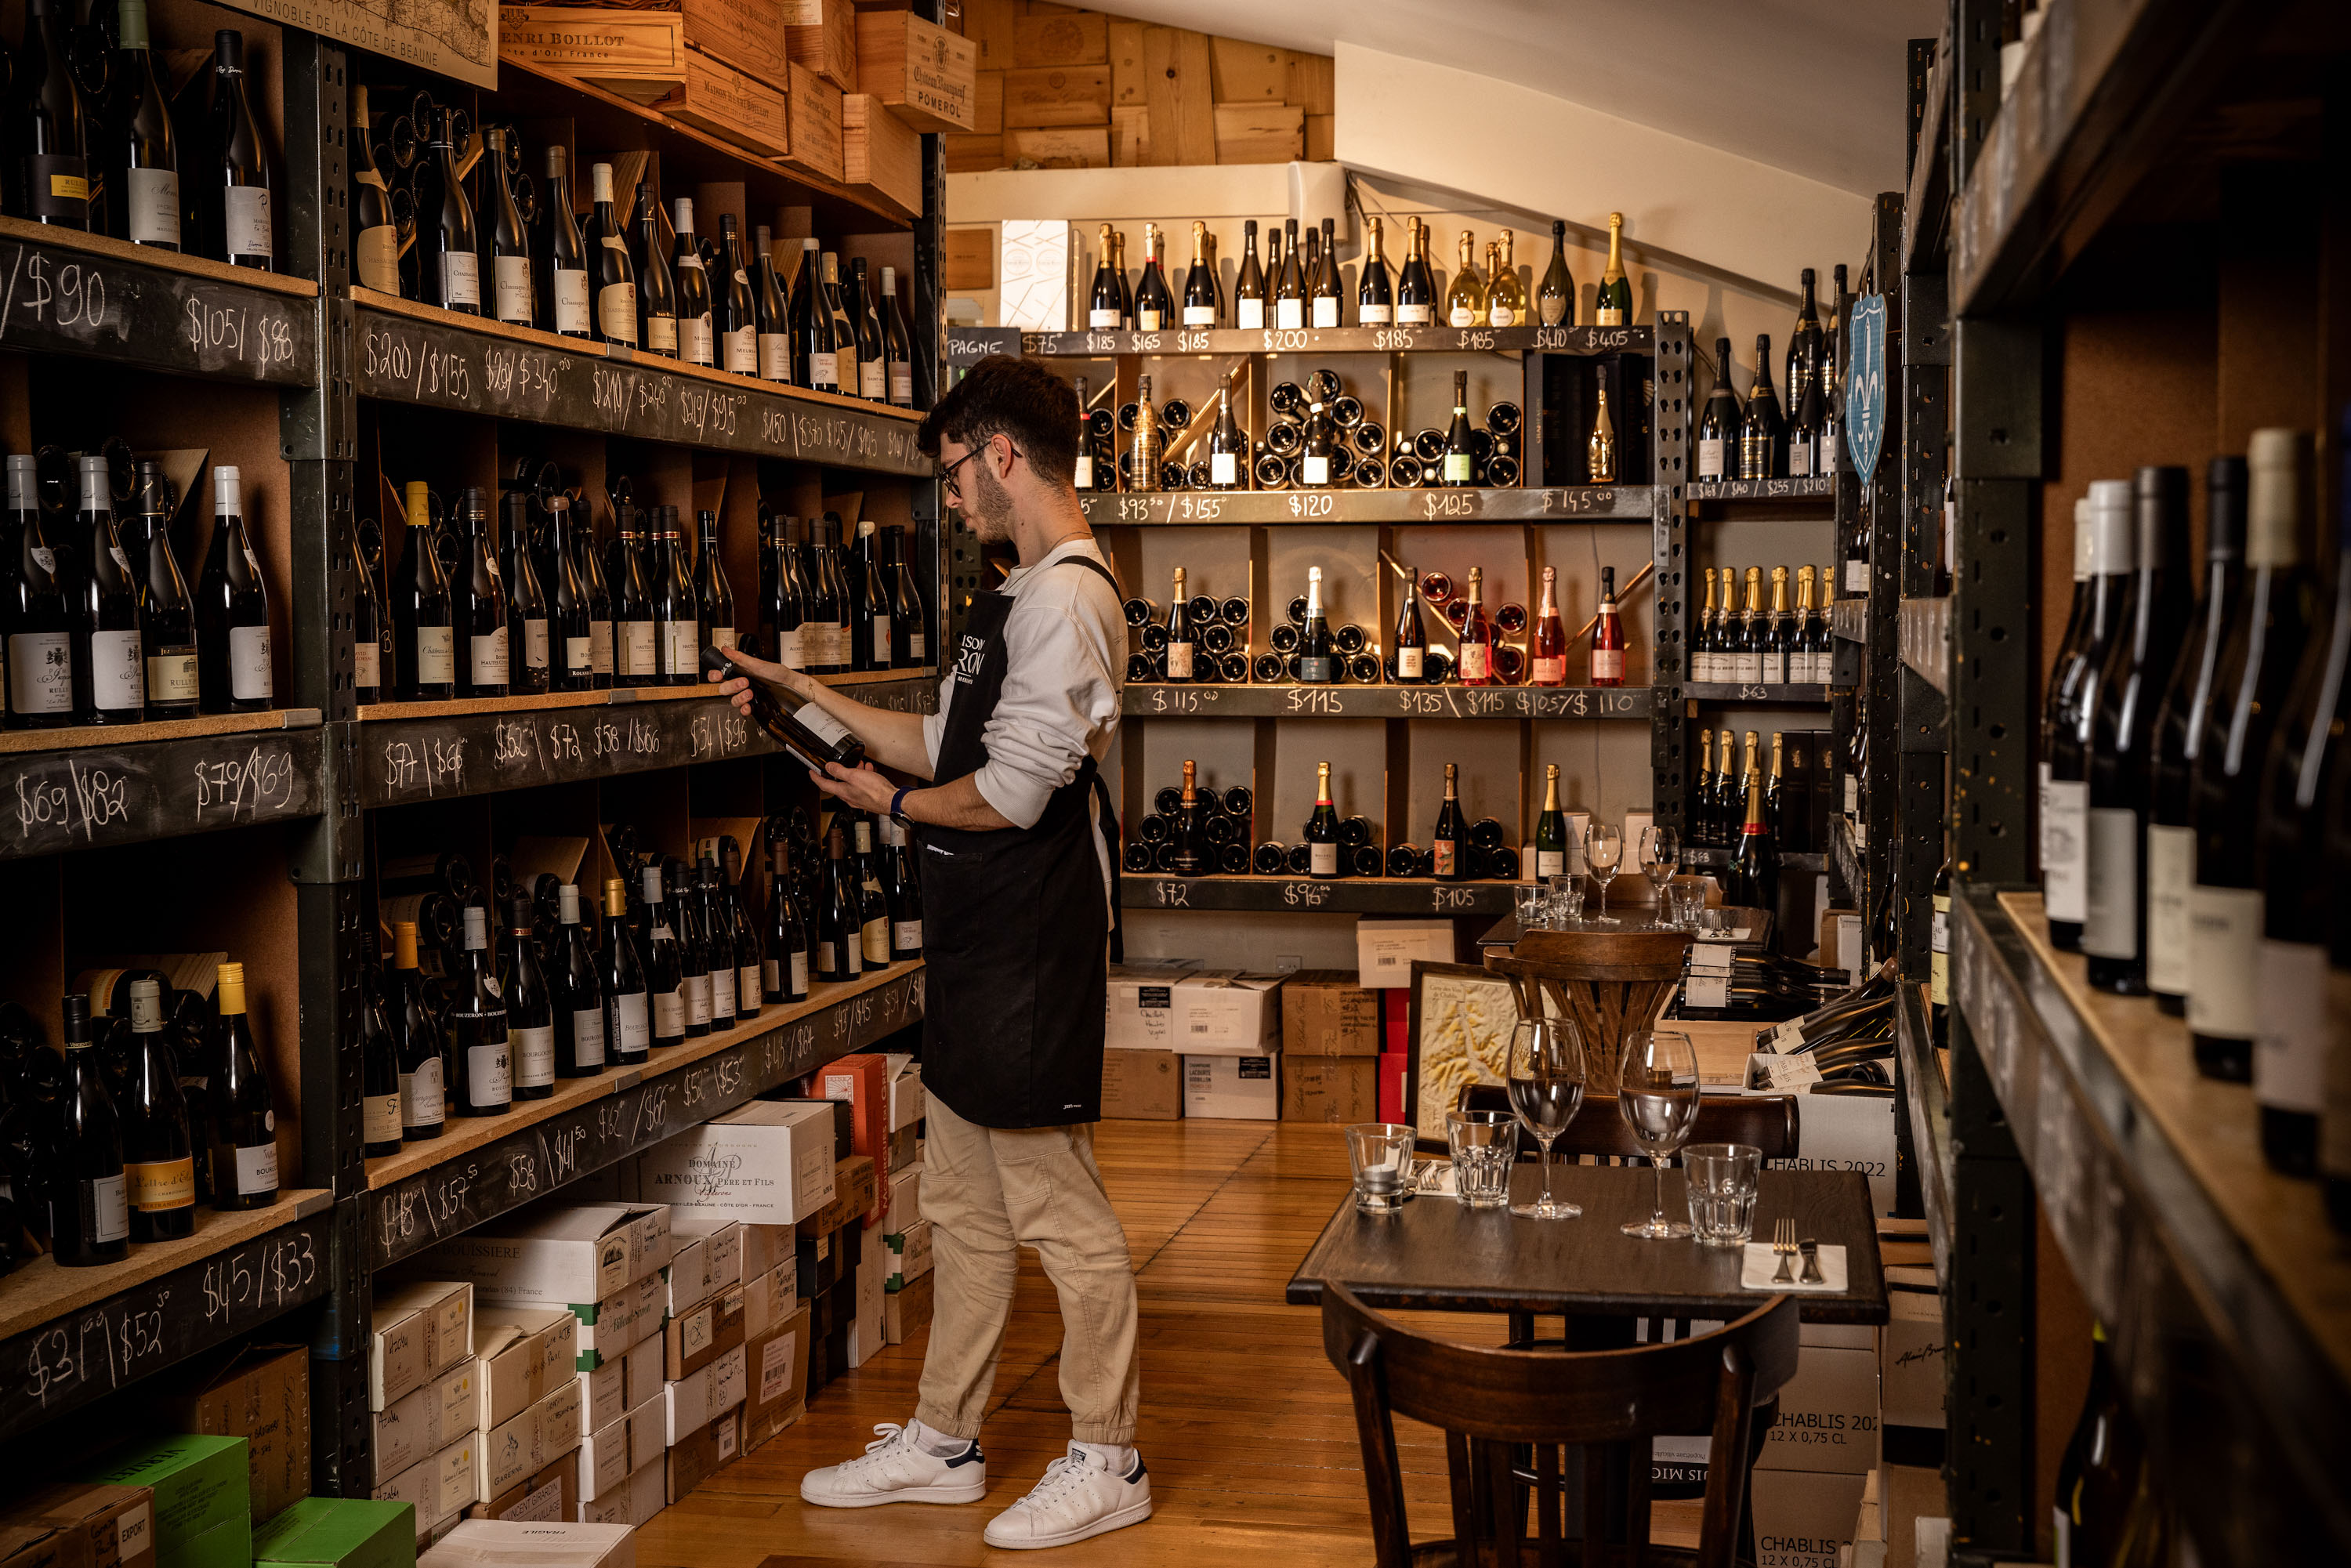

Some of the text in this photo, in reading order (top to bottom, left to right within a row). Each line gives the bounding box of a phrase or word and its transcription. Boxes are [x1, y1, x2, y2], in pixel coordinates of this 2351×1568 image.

[748, 5, 777, 31] BOILLOT
[252, 1, 438, 67] VIGNOBLE DE LA CÔTE DE BEAUNE
[550, 32, 625, 47] BOILLOT
[533, 49, 563, 58] d'Or)
[705, 80, 726, 100] MAISON
[728, 92, 745, 108] HENRI
[747, 100, 770, 118] BOILLOT
[918, 91, 961, 118] POMEROL
[947, 339, 1004, 356] PAGNE
[1086, 331, 1116, 351] $185
[1132, 331, 1161, 351] $165
[1177, 331, 1209, 351] $185
[1263, 330, 1308, 352] $200
[1373, 328, 1414, 351] $185
[1457, 328, 1495, 350] $185
[1586, 327, 1629, 349] $405
[429, 347, 469, 400] $155
[1288, 494, 1333, 517] $120
[1423, 493, 1474, 520] $125
[1287, 689, 1343, 713] $115
[1400, 690, 1443, 712] $135
[1466, 690, 1505, 715] $115
[1738, 683, 1768, 701] $63
[550, 724, 583, 762] $72
[593, 715, 620, 759] $58
[724, 712, 747, 752] $96
[1156, 882, 1190, 907] $72
[1432, 886, 1475, 913] $105
[688, 1158, 736, 1168] DOMAINE
[1845, 1161, 1886, 1177] 2022
[654, 1174, 712, 1186] ARNOUX
[754, 1178, 774, 1186] FILS
[270, 1232, 316, 1307] $33
[501, 1285, 516, 1295] (84)
[518, 1286, 544, 1295] France
[1770, 1431, 1847, 1445] 12 X 0,75 CL
[494, 1464, 523, 1487] GARENNE
[507, 1481, 558, 1520] VINCENT GIRARDIN
[122, 1519, 145, 1542] EXPORT
[1761, 1536, 1837, 1555] CHABLIS
[1762, 1555, 1775, 1565] 12
[1781, 1555, 1790, 1566] X
[1793, 1556, 1820, 1568] 0,75
